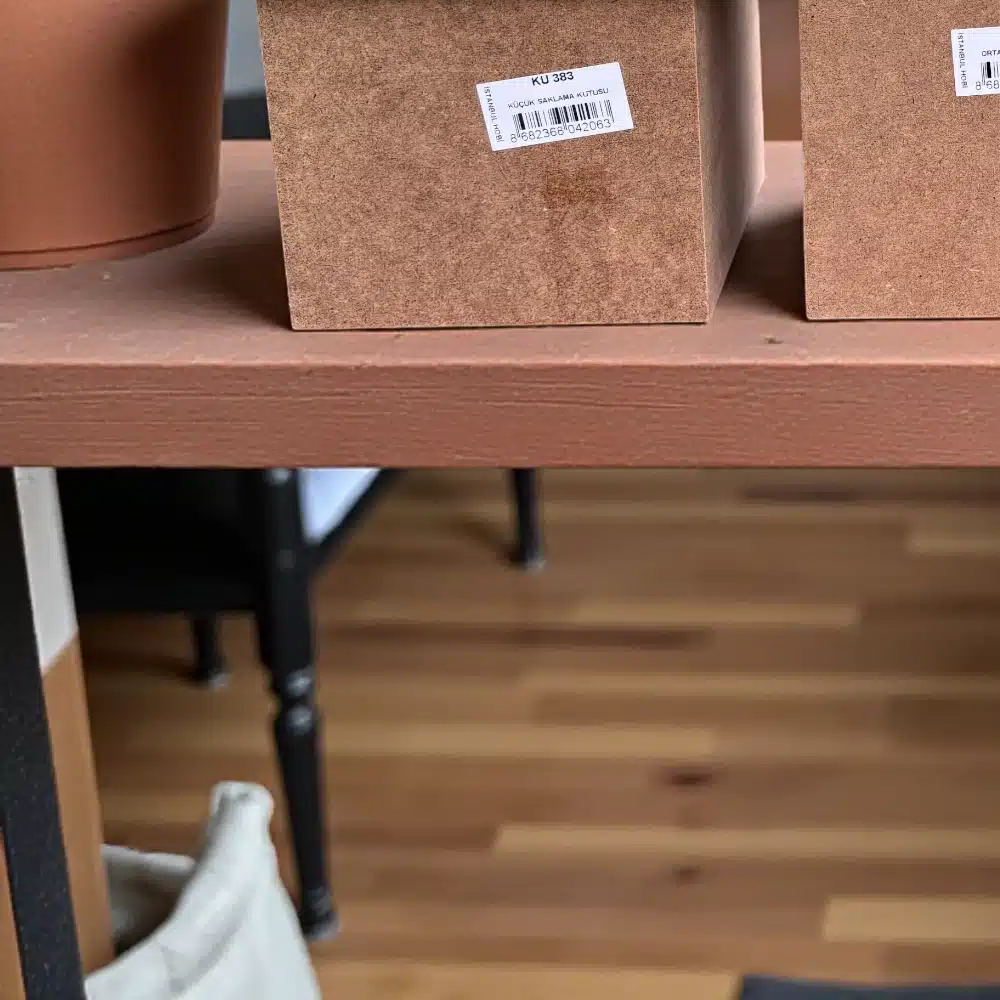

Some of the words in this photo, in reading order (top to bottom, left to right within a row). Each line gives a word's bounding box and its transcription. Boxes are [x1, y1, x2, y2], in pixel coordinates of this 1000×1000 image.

[531, 74, 549, 86] KU
[552, 71, 574, 83] 383
[537, 93, 575, 105] SAKLAMA
[576, 87, 609, 98] KUTUSU
